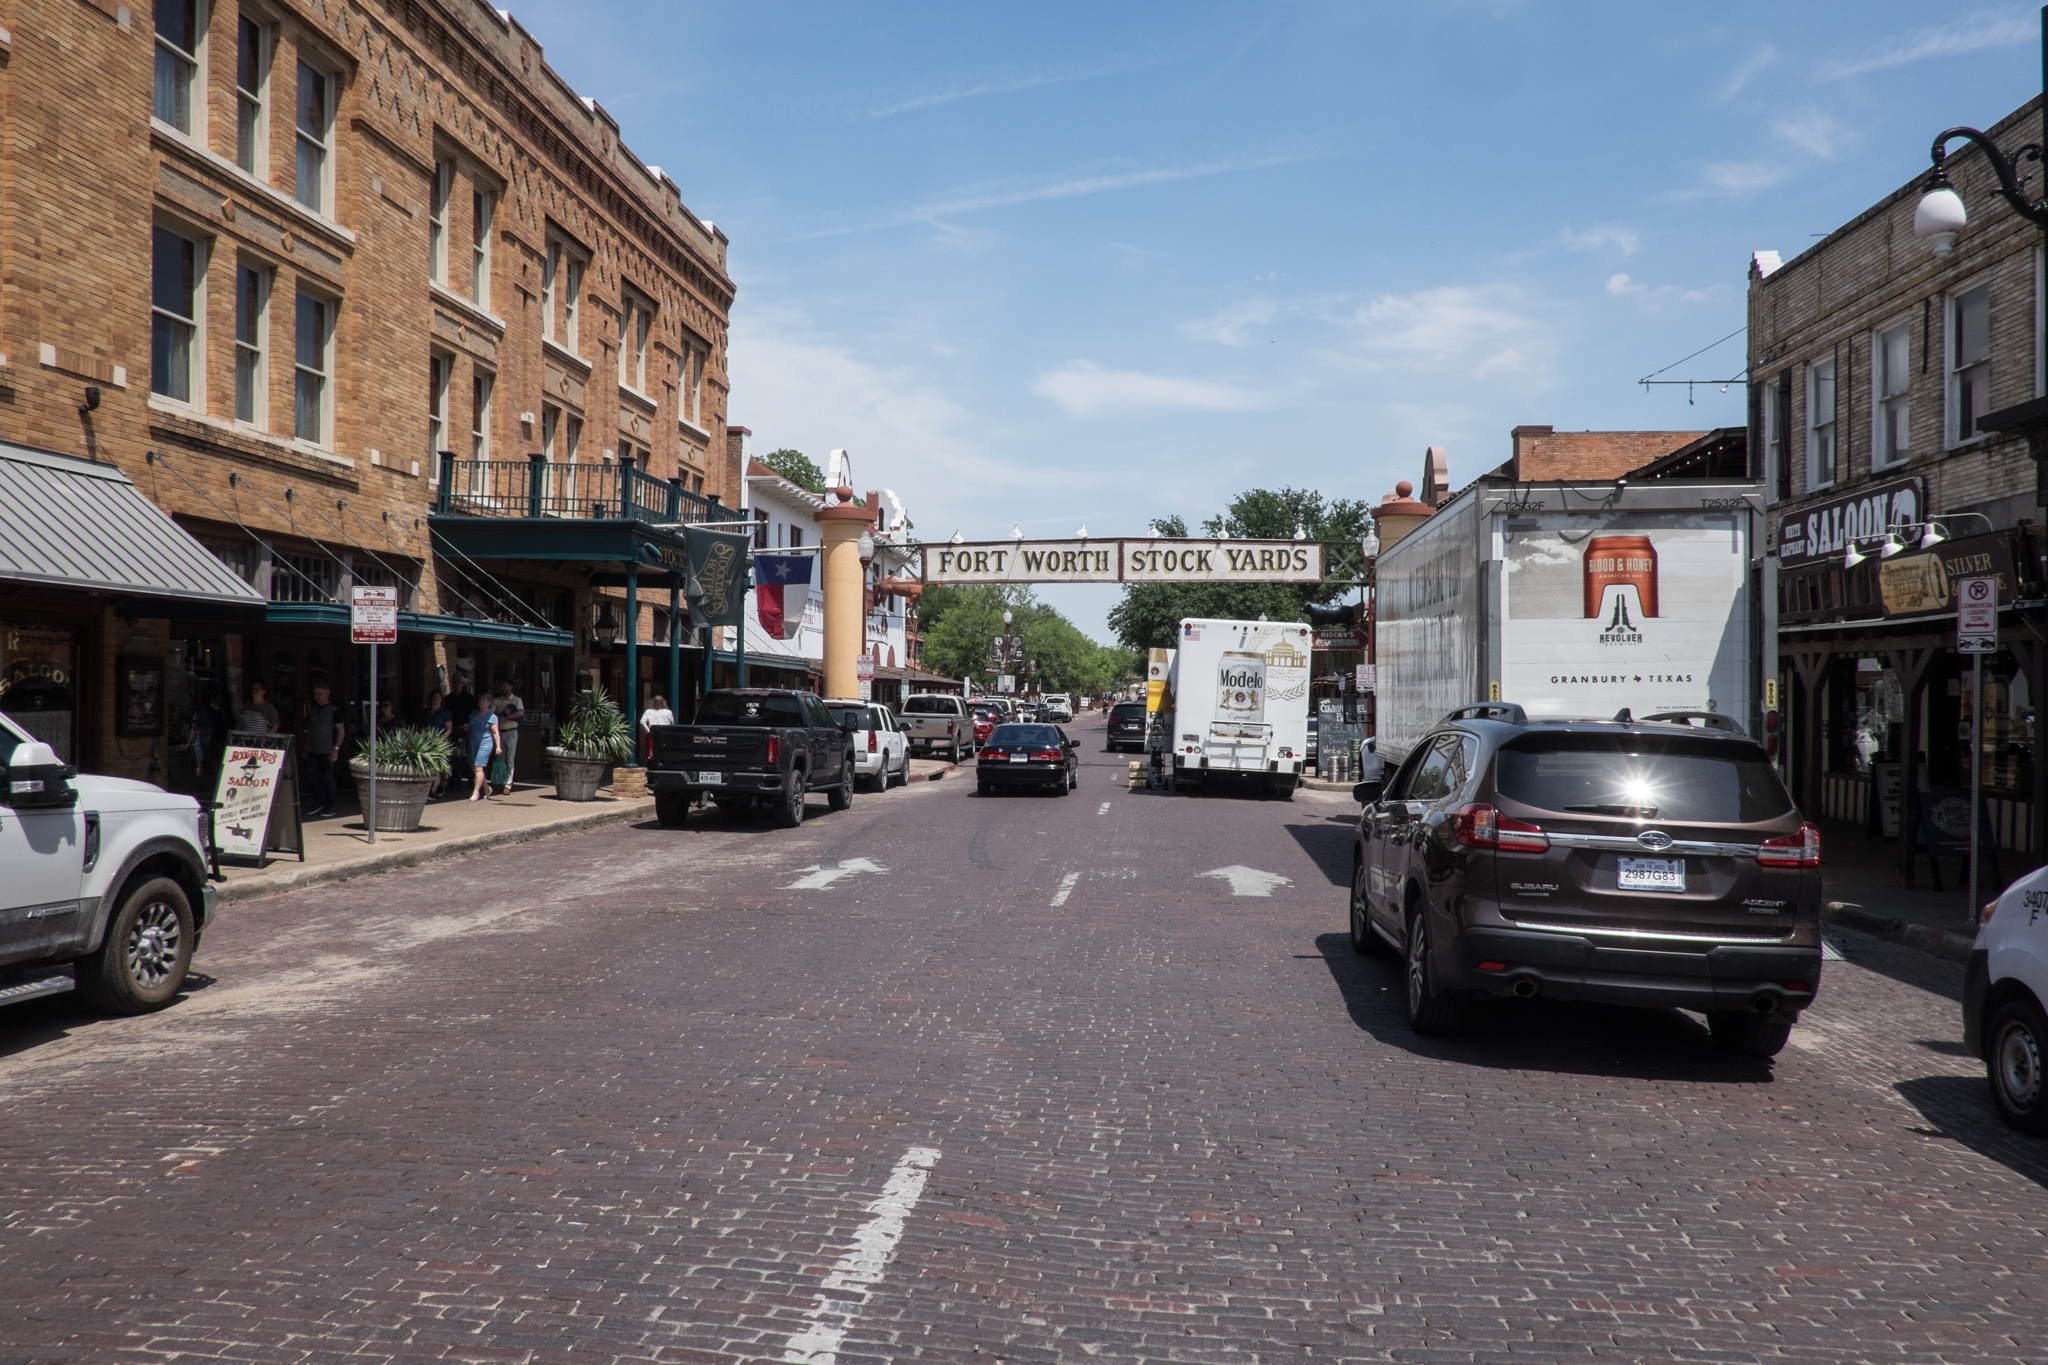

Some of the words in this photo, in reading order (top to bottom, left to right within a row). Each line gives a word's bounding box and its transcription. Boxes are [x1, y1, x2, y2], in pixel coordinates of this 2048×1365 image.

[1502, 501, 1545, 511] T2532F
[1701, 499, 1743, 508] T2532F
[1785, 523, 1801, 539] WHITE
[1807, 493, 1888, 557] SALOON
[1780, 540, 1804, 557] ELEPHANT
[937, 550, 1008, 575] FORT
[1020, 550, 1110, 575] WORTH
[1130, 549, 1213, 574] STOCK
[1225, 548, 1308, 574] YARDS
[1589, 558, 1614, 573] BLOOD
[1617, 557, 1624, 572] &
[1627, 558, 1652, 572] HONEY
[1945, 553, 1992, 576] SILVER
[700, 558, 717, 596] HOTEL
[705, 543, 735, 615] STOCKYARDS
[1599, 634, 1643, 643] REVOLVER
[1220, 668, 1263, 689] Modelo
[1550, 675, 1626, 684] GRANBURY
[1649, 674, 1693, 683] TEXAS
[693, 736, 728, 744] GMC
[228, 750, 260, 763] BOOGER
[228, 776, 270, 787] SALOON
[1625, 868, 1676, 881] 2987G83
[1510, 882, 1559, 891] SUBARU
[1741, 898, 1787, 907] ASCENT
[2029, 909, 2040, 927] F
